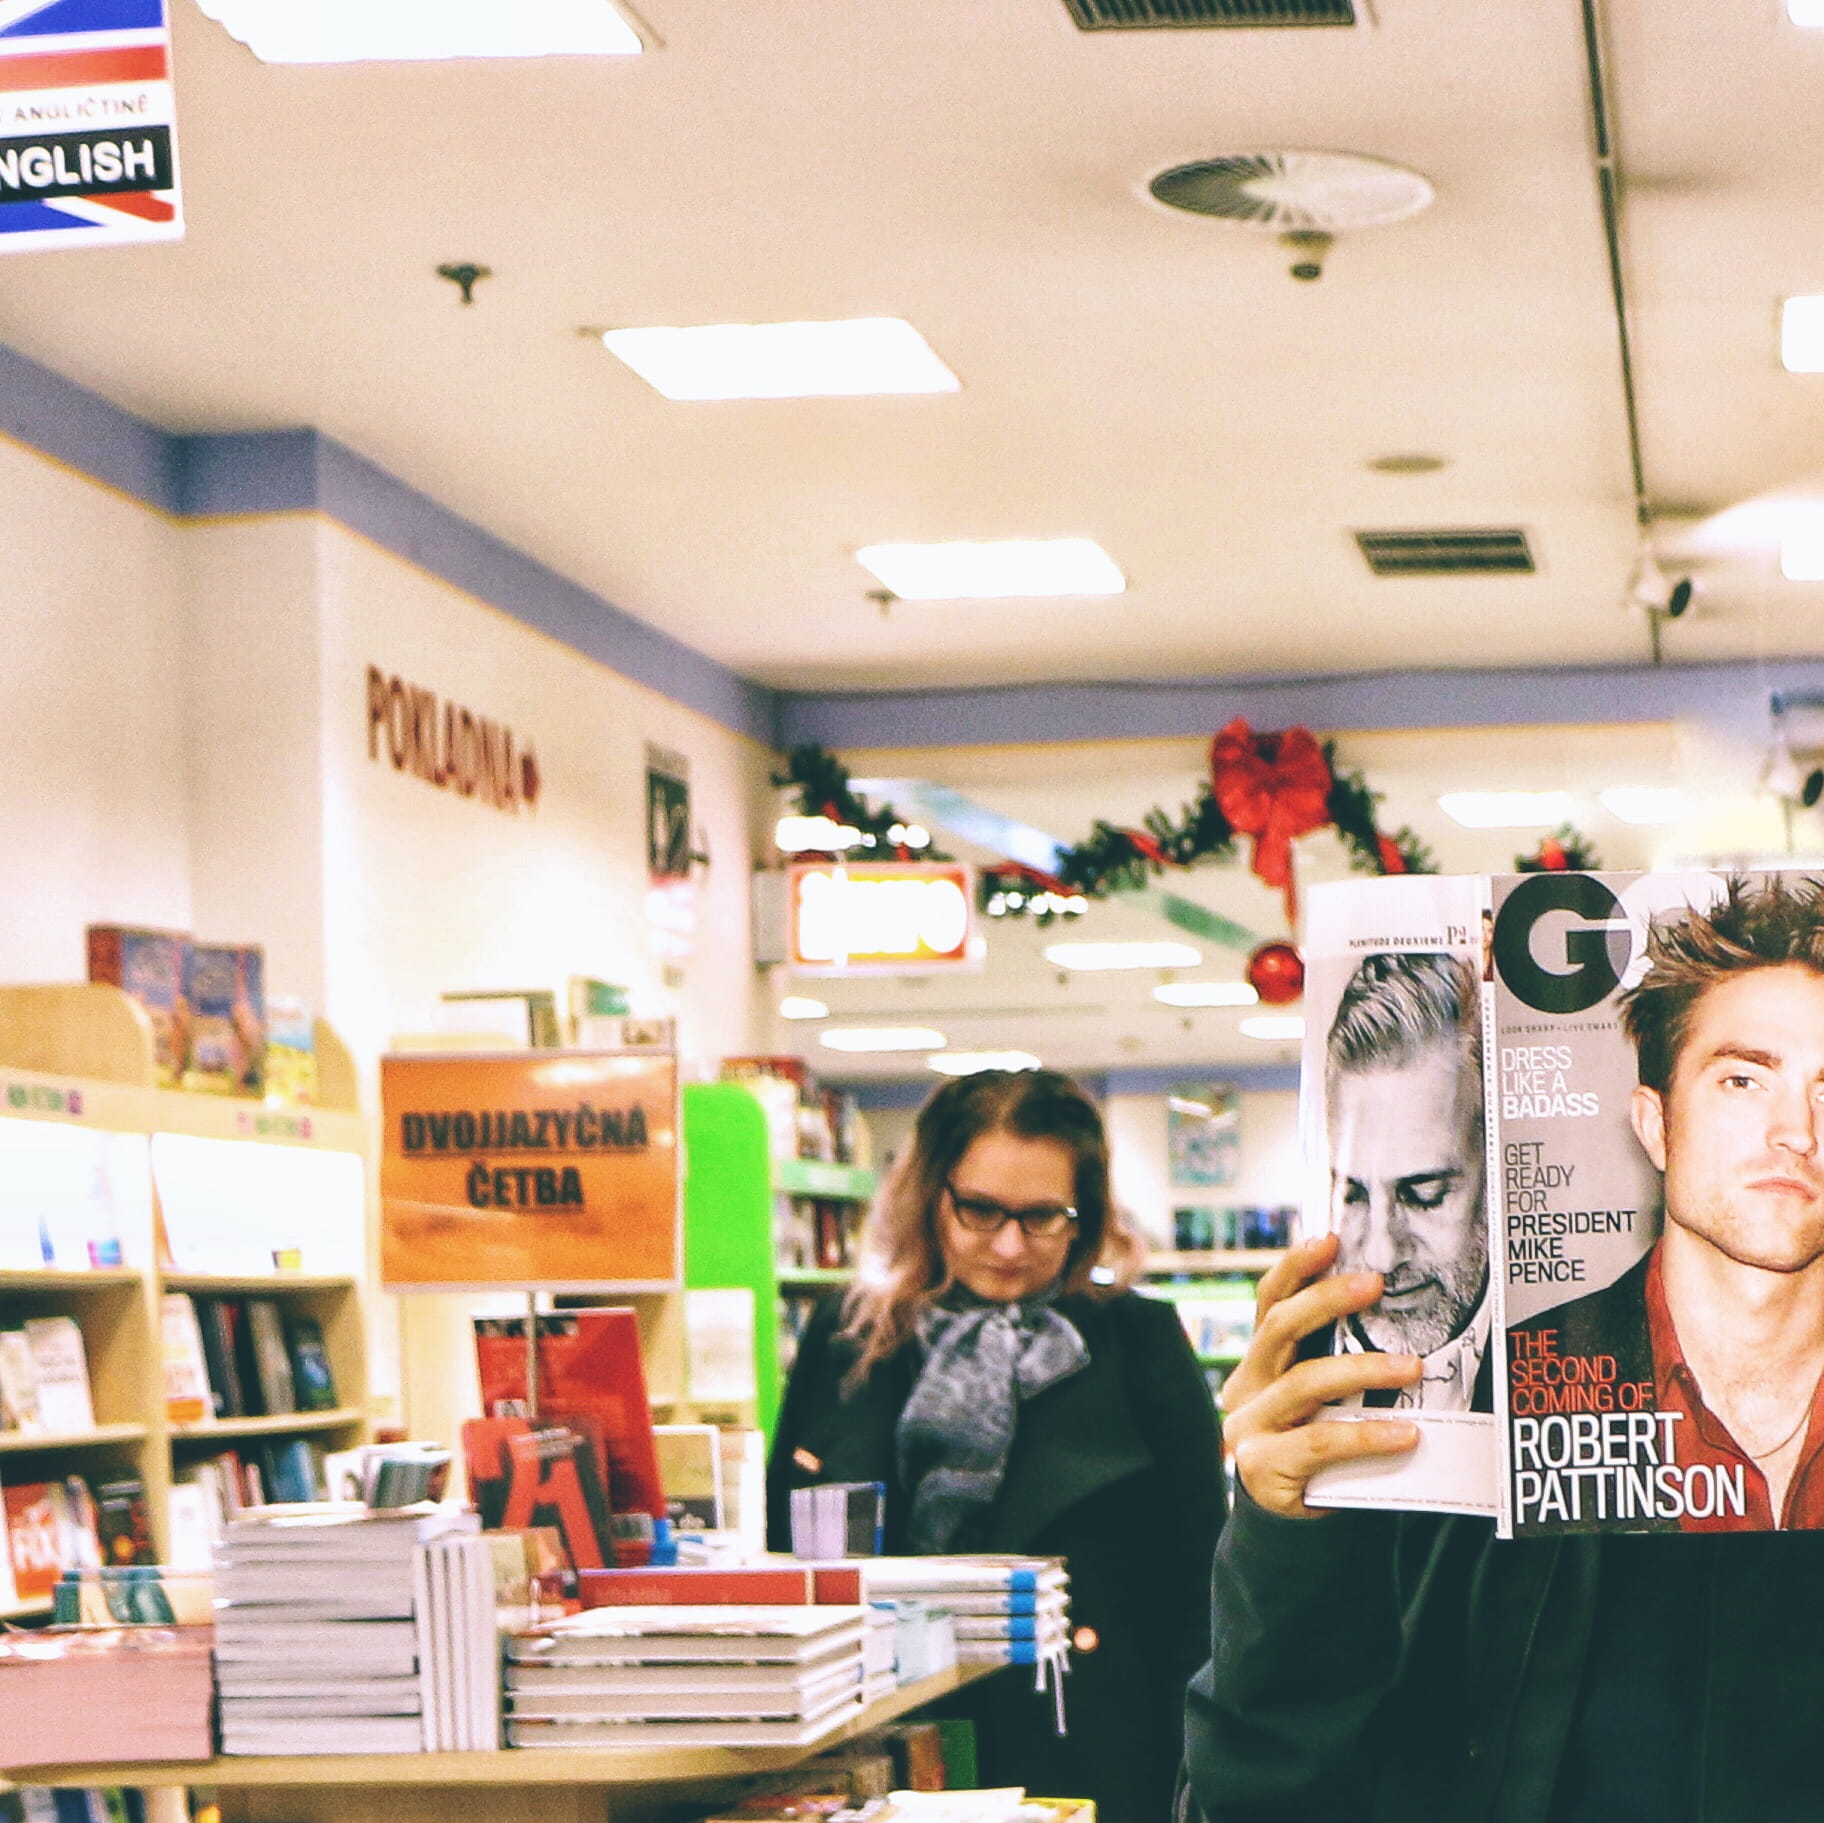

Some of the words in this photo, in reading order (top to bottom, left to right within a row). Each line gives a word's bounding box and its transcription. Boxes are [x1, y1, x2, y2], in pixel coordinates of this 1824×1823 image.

[1502, 1046, 1572, 1072] DRESS
[1503, 1070, 1546, 1096] LIKE
[1551, 1070, 1568, 1093] A
[1502, 1092, 1599, 1120] BADASS
[401, 1101, 648, 1151] DVOJJAZYČNÁ
[1505, 1142, 1544, 1166] GET
[466, 1158, 585, 1208] ČETBA
[1505, 1165, 1575, 1189] READY
[1506, 1189, 1548, 1214] FOR
[1507, 1210, 1637, 1237] PRESIDENT
[1508, 1236, 1564, 1261] MIKE
[1509, 1260, 1586, 1285] PENCE
[1509, 1330, 1559, 1359] THE
[1511, 1355, 1617, 1388] SECOND
[1511, 1384, 1615, 1416] COMING
[1618, 1382, 1656, 1410] OF
[1513, 1411, 1685, 1472] ROBERT
[1515, 1463, 1746, 1525] PATTINSON
